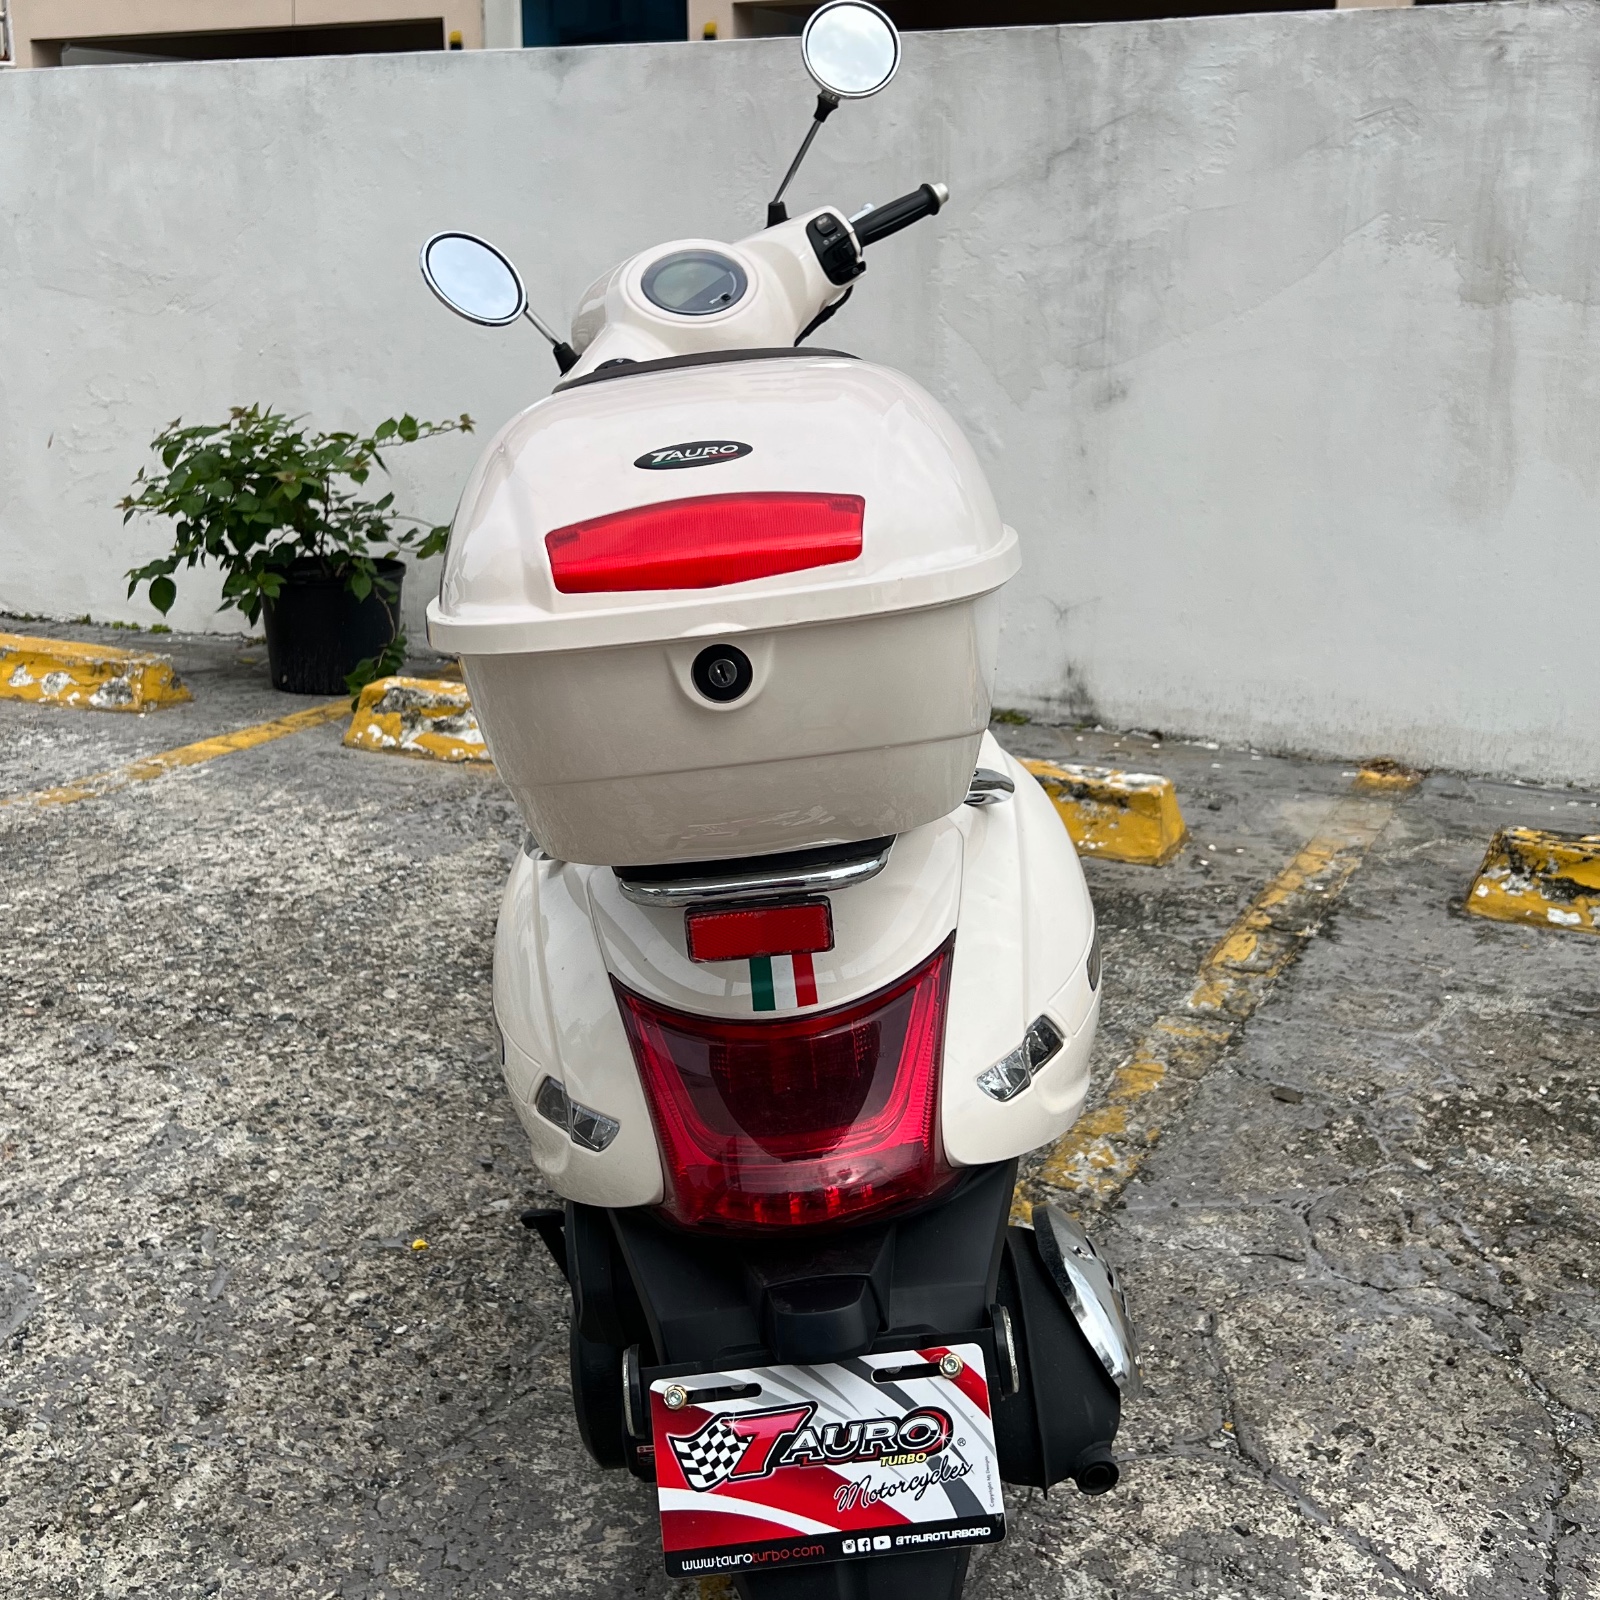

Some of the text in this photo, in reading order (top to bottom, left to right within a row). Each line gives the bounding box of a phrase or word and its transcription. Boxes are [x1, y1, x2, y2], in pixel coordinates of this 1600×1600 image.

[651, 444, 739, 463] TAURO
[722, 1404, 953, 1476] TAURO
[880, 1452, 927, 1467] TURBO
[834, 1457, 973, 1510] Motorcycles
[895, 1526, 991, 1545] @TAUROTURBORD
[681, 1544, 825, 1571] www.tauroturbo.com
